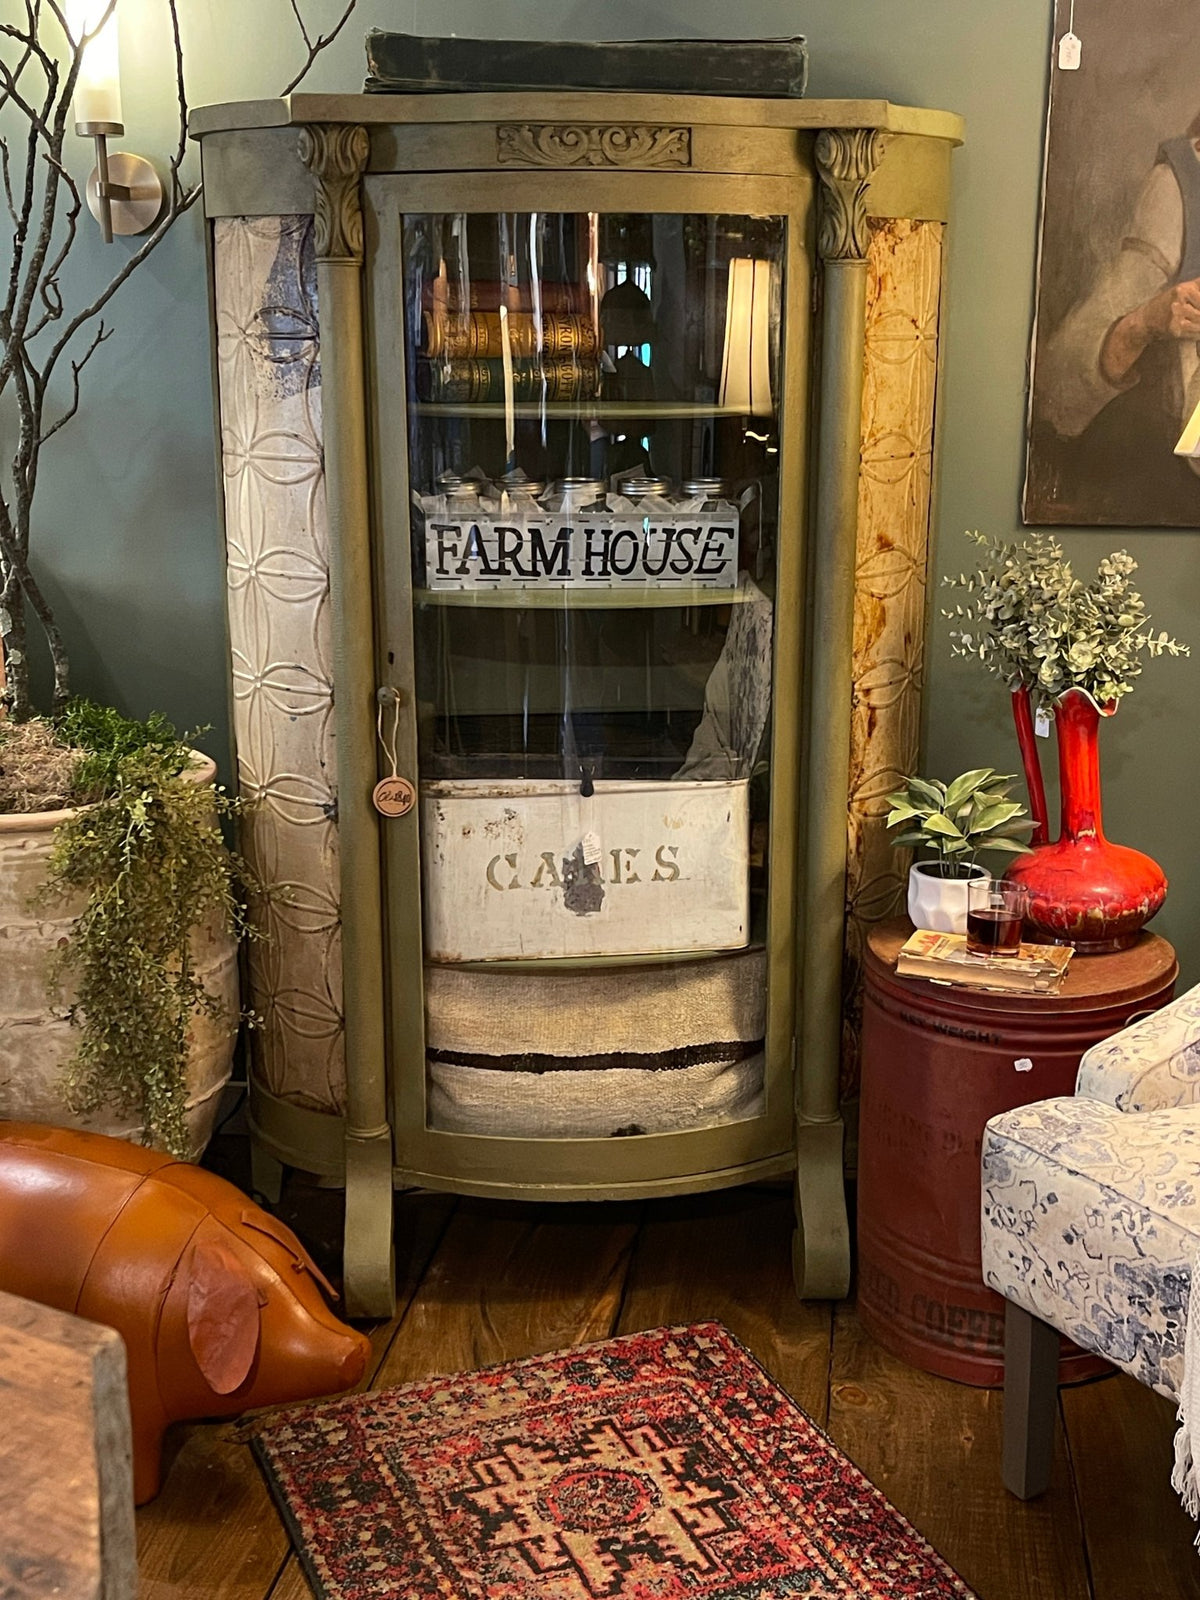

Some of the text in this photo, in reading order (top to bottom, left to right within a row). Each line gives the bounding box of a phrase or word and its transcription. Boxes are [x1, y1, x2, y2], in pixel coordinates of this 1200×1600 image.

[430, 523, 735, 577] FARM HOUSE
[486, 845, 680, 891] CAES
[932, 1019, 1002, 1045] WEIGHT
[911, 1294, 1006, 1347] COFFE
